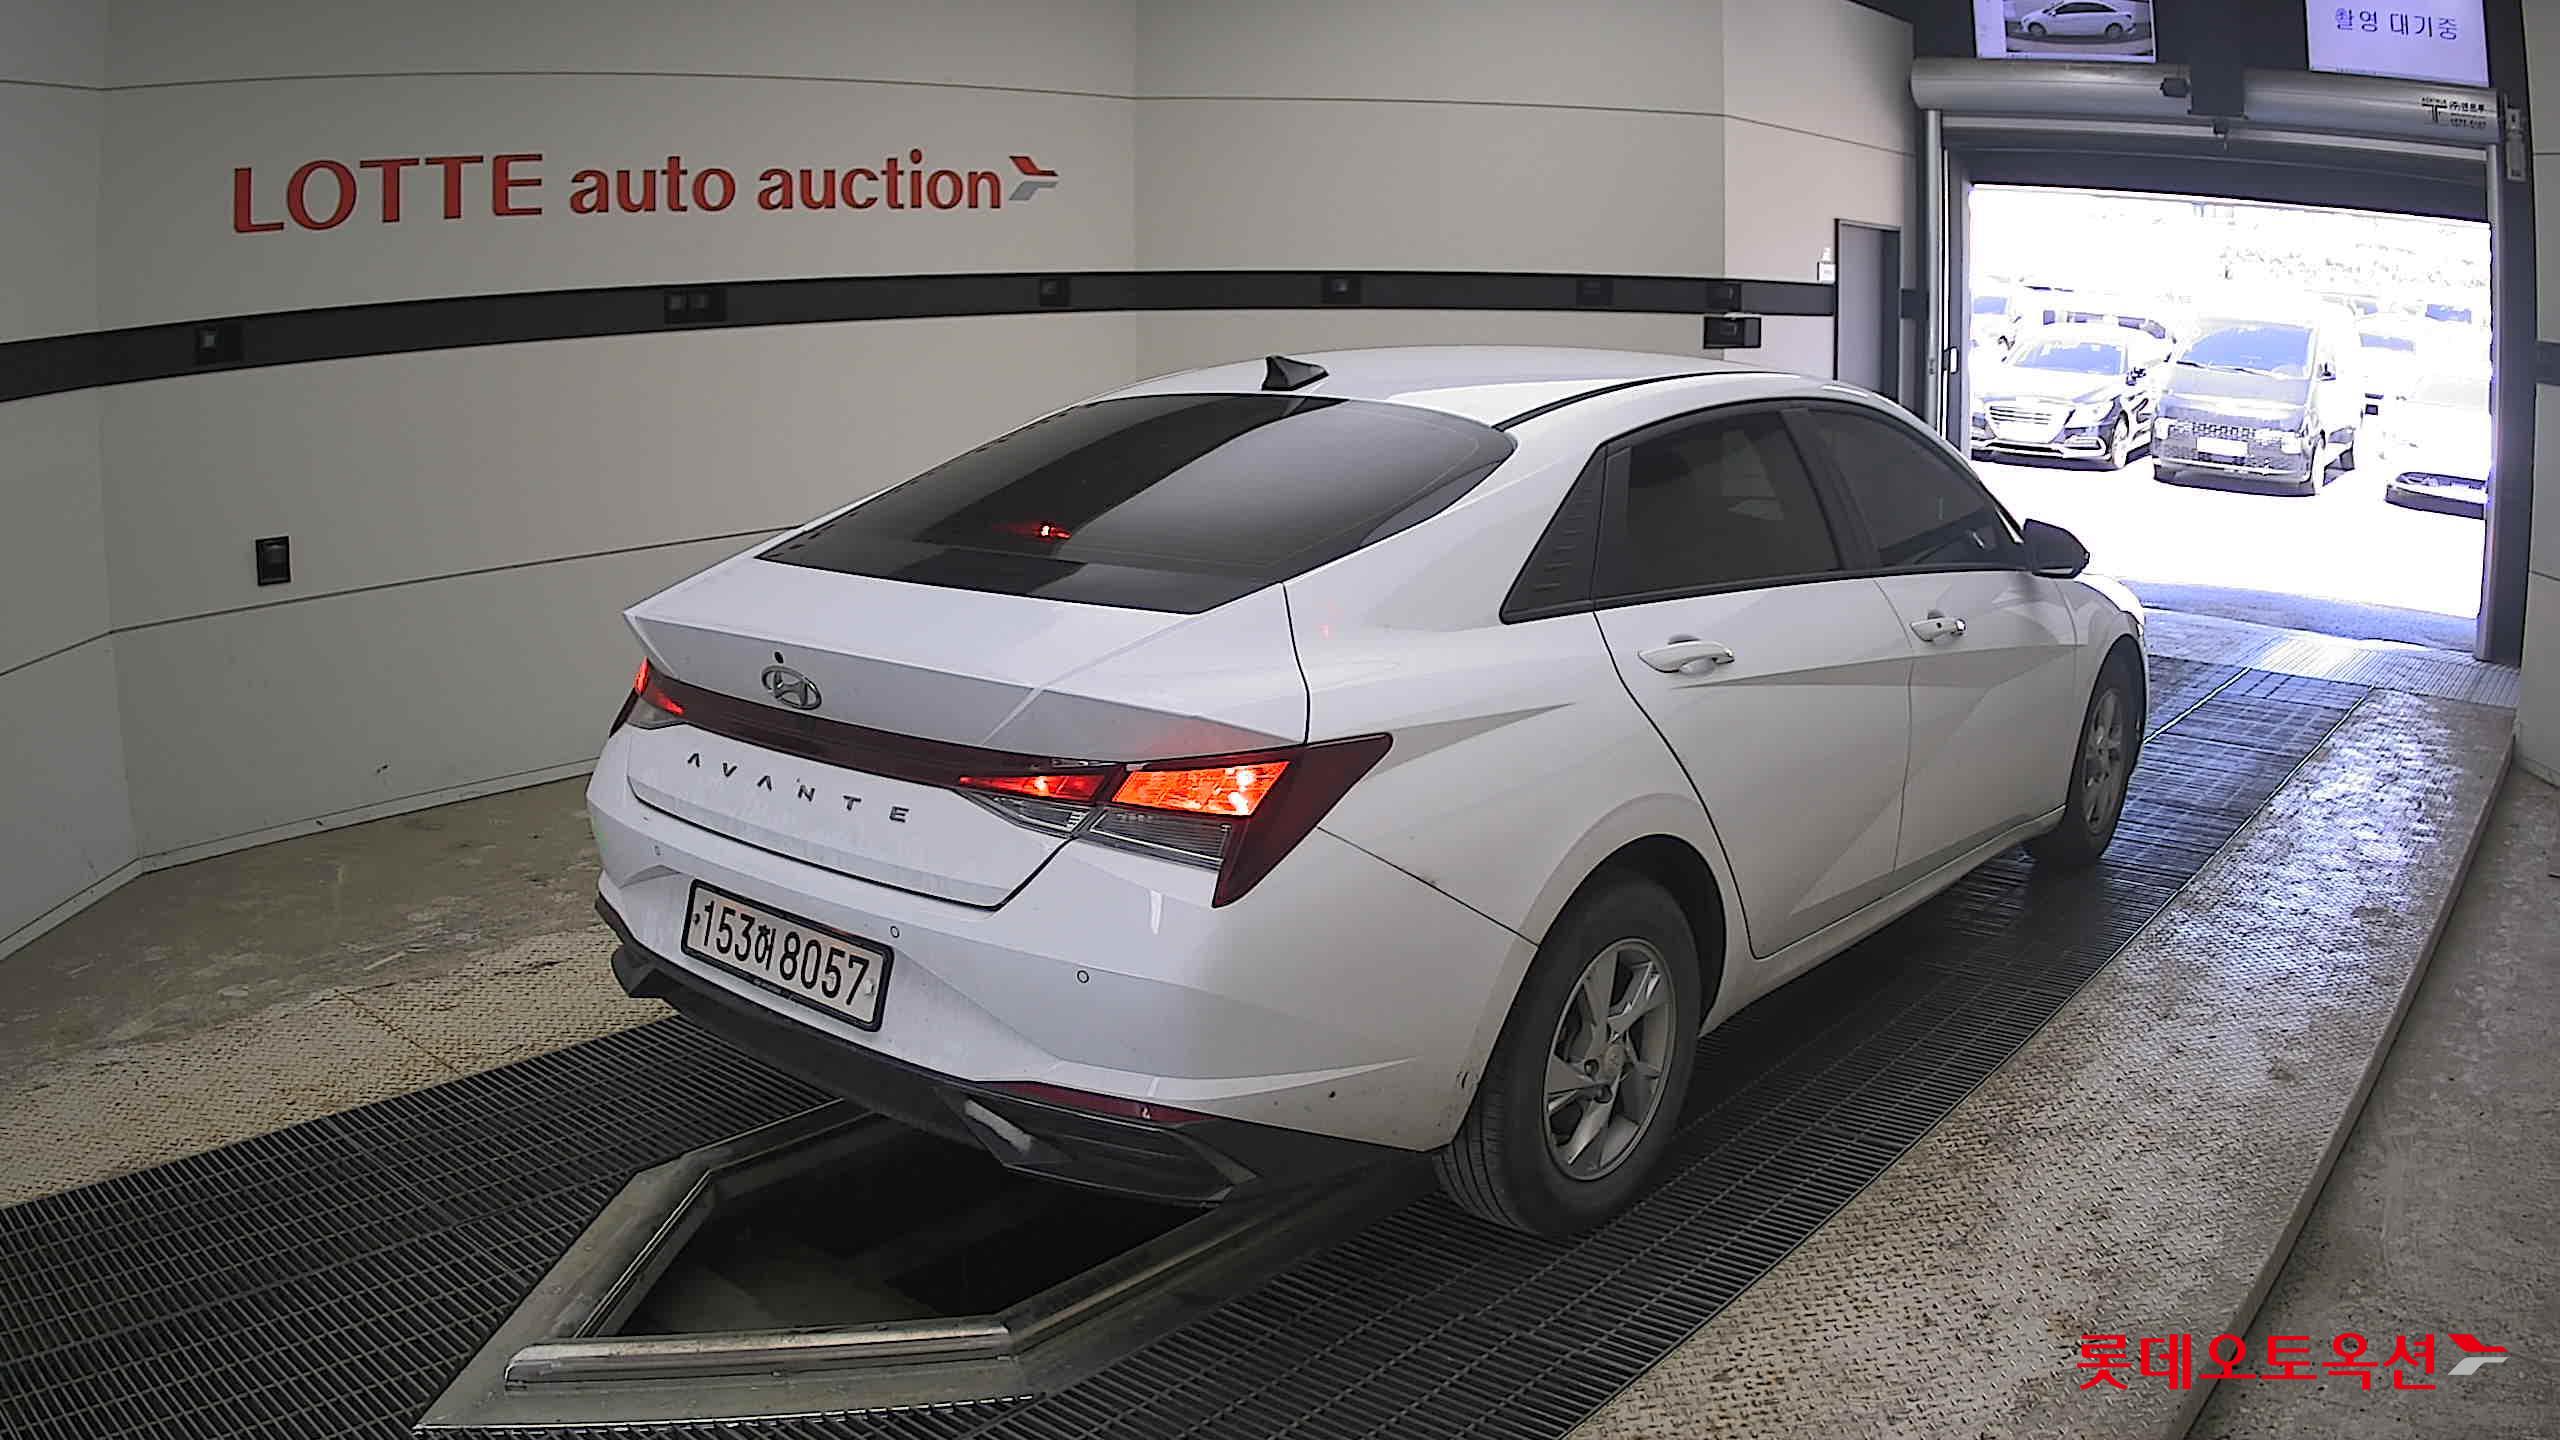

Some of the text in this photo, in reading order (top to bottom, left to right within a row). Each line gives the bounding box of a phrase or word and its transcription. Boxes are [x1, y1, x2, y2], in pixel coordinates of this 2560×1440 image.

[2335, 8, 2457, 40] 촬영 대기중
[234, 149, 1003, 233] LOTTE auto auction
[687, 752, 909, 823] AVANTE
[703, 899, 870, 1006] 153허8057
